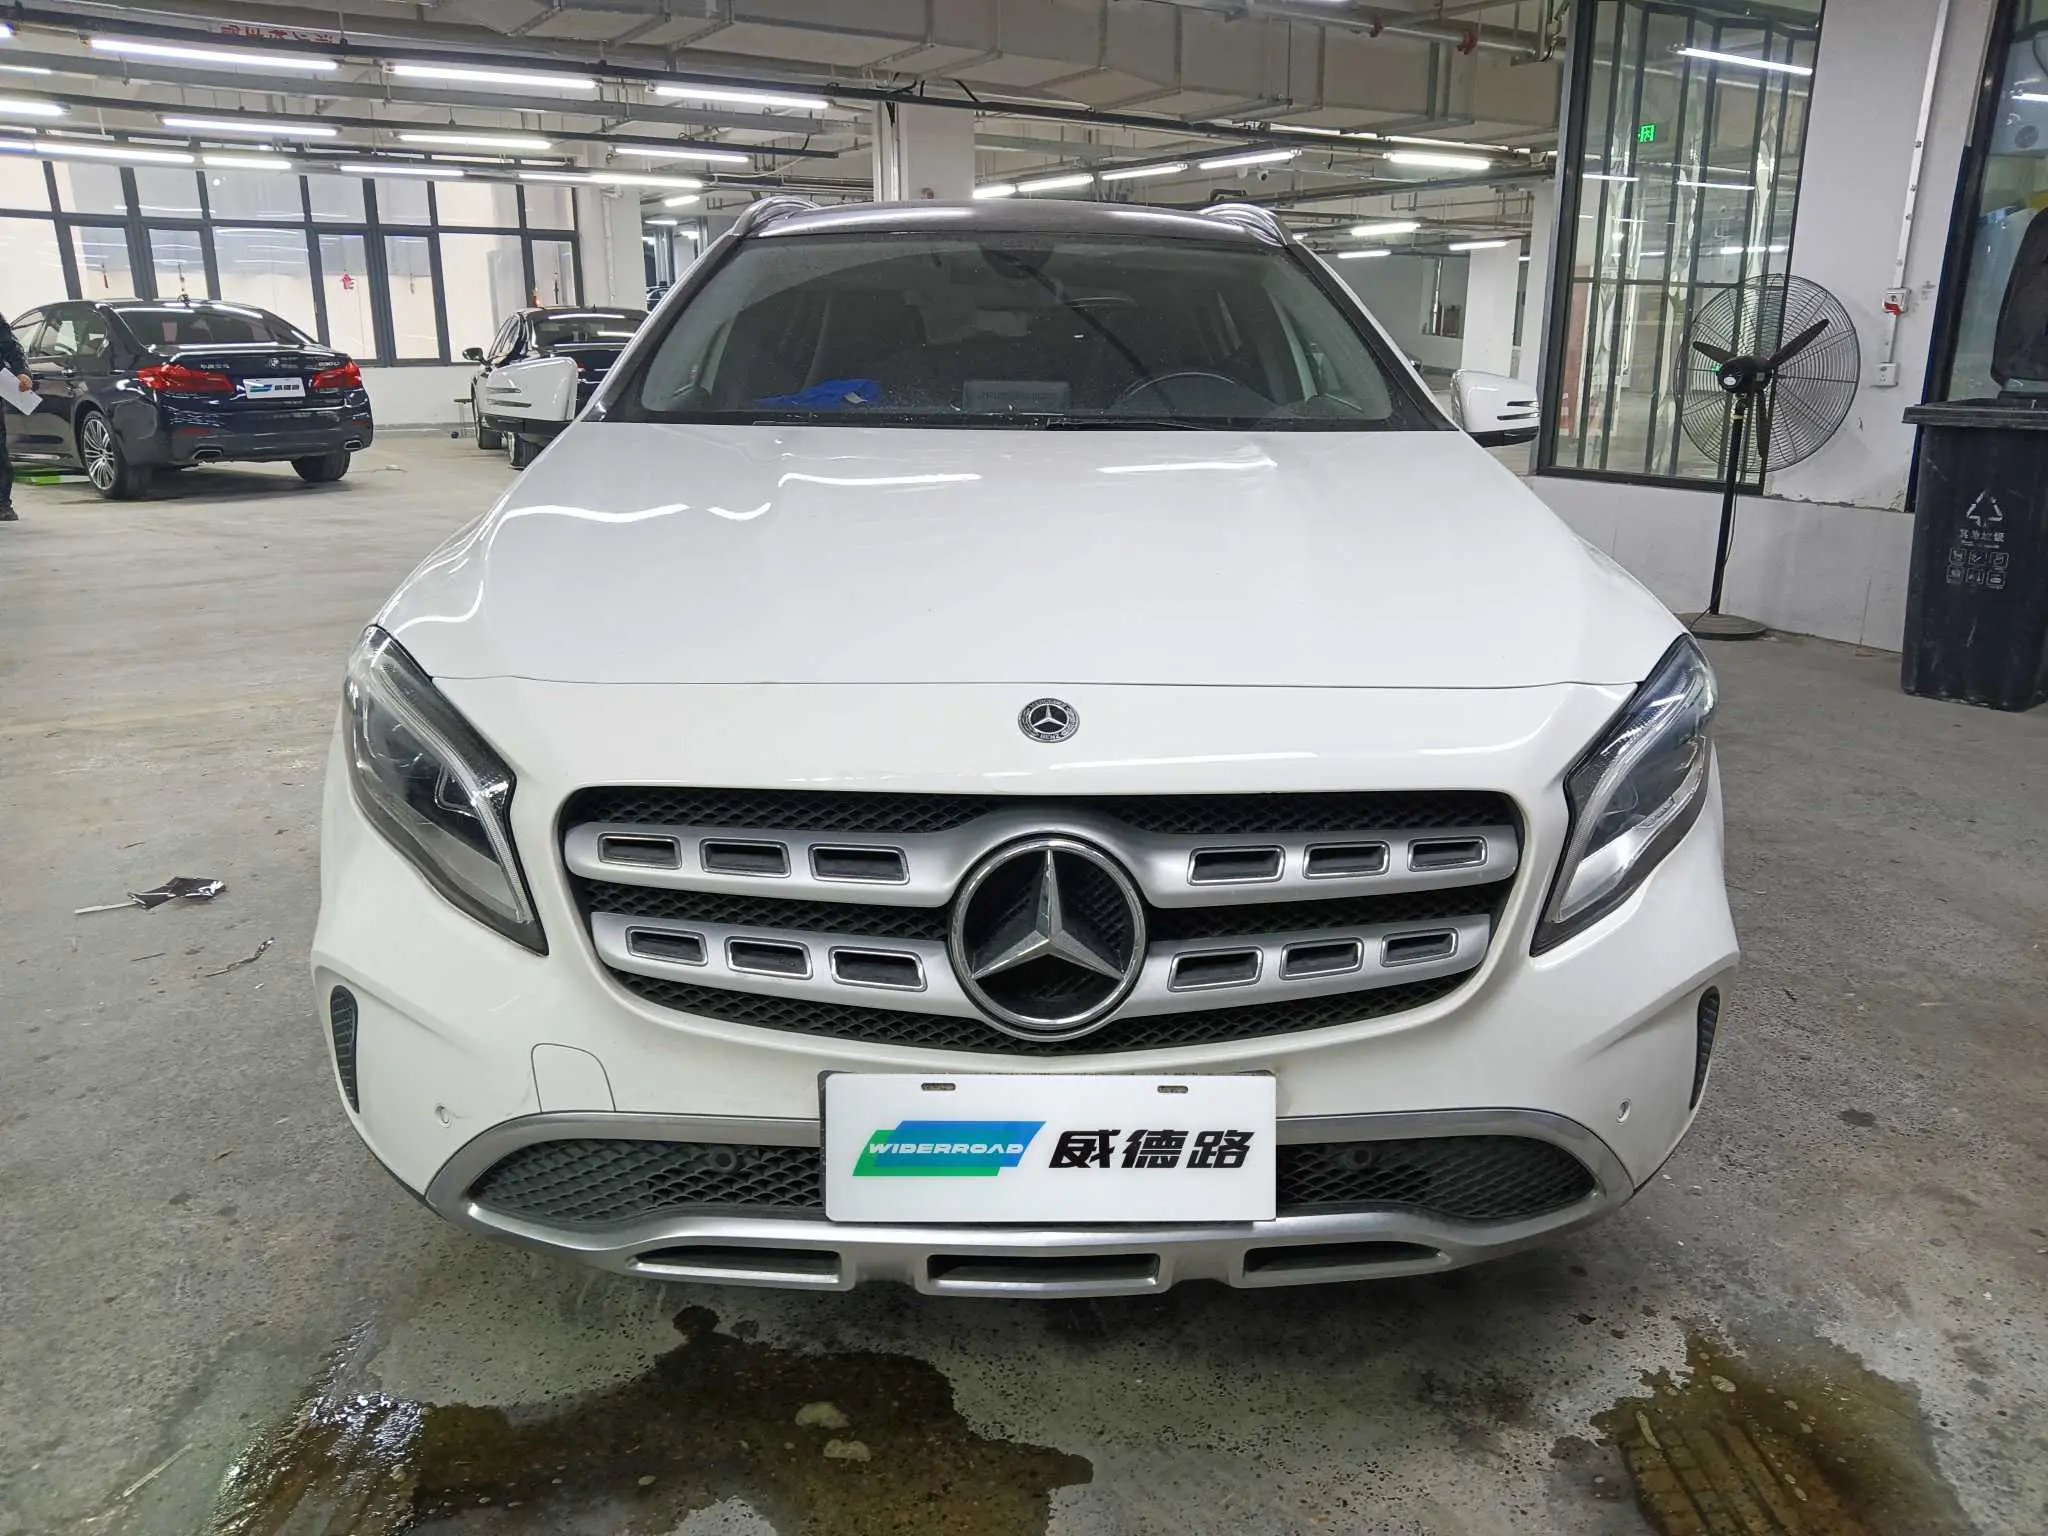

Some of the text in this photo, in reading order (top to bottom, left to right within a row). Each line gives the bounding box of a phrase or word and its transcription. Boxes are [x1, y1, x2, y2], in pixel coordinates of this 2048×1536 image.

[868, 1143, 1025, 1154] WIDERROAD
[1048, 1129, 1255, 1169] 威德路
